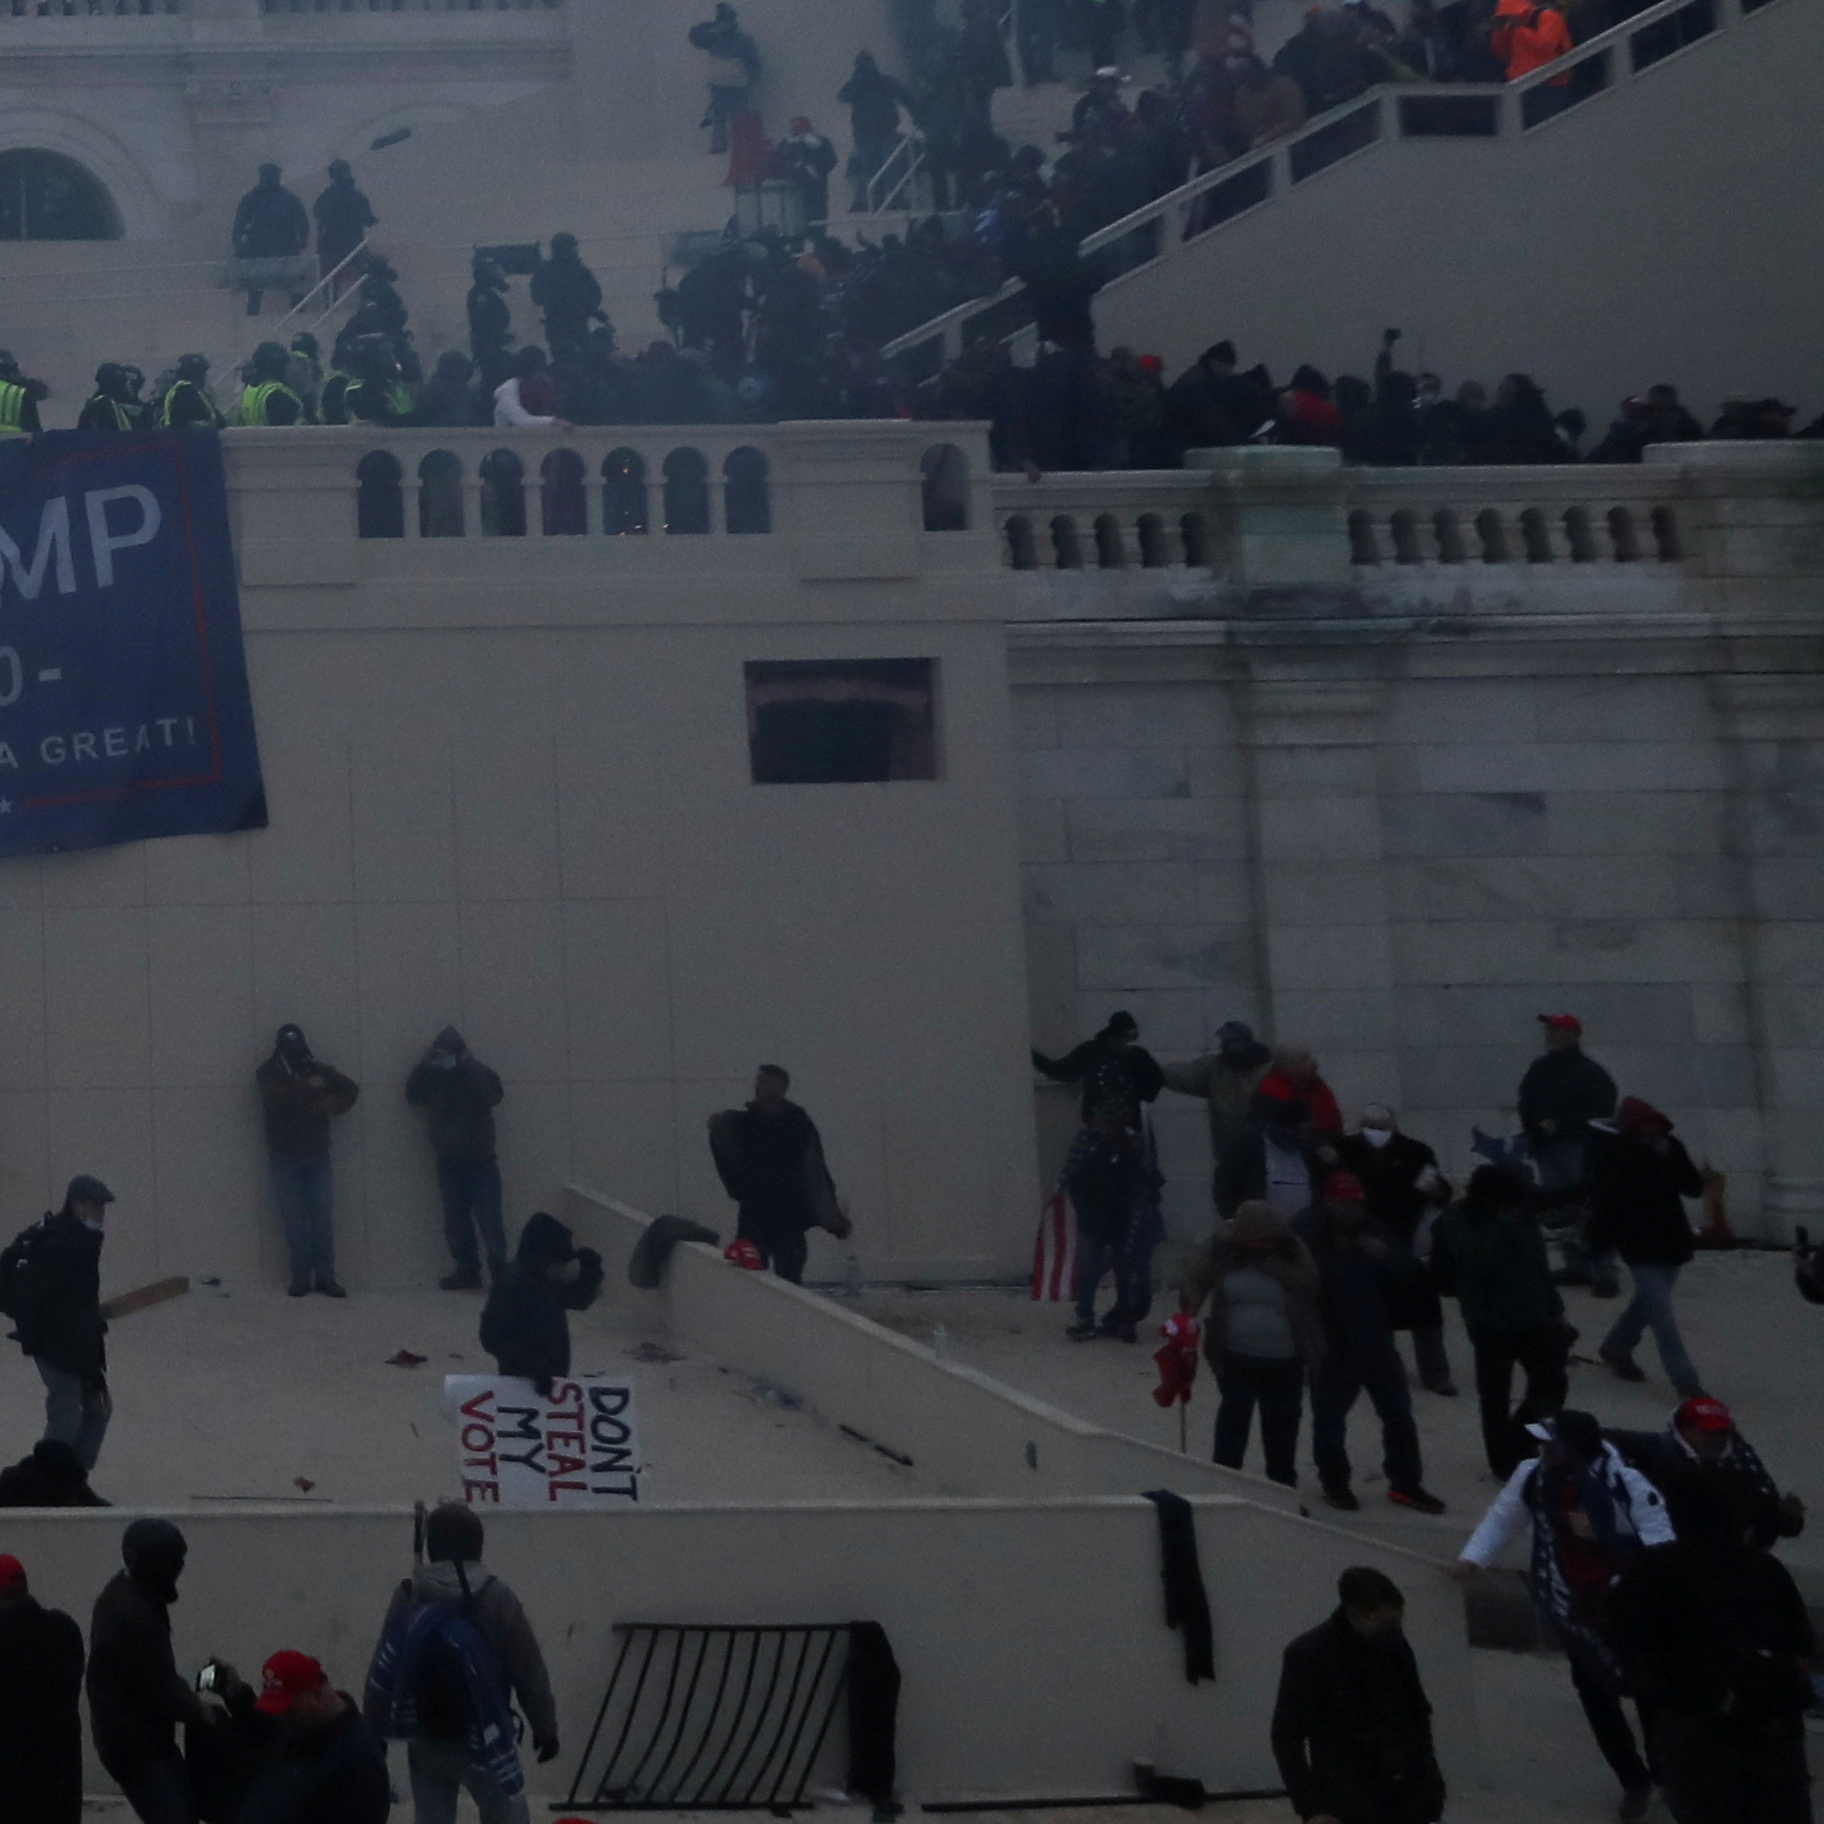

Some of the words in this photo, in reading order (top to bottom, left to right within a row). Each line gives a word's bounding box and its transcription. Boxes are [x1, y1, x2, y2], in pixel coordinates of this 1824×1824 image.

[39, 716, 196, 766] GREAT!
[460, 1390, 499, 1502] VOTE
[497, 1406, 546, 1473] MY
[547, 1379, 587, 1501] STEAL
[589, 1387, 641, 1501] DON'T
